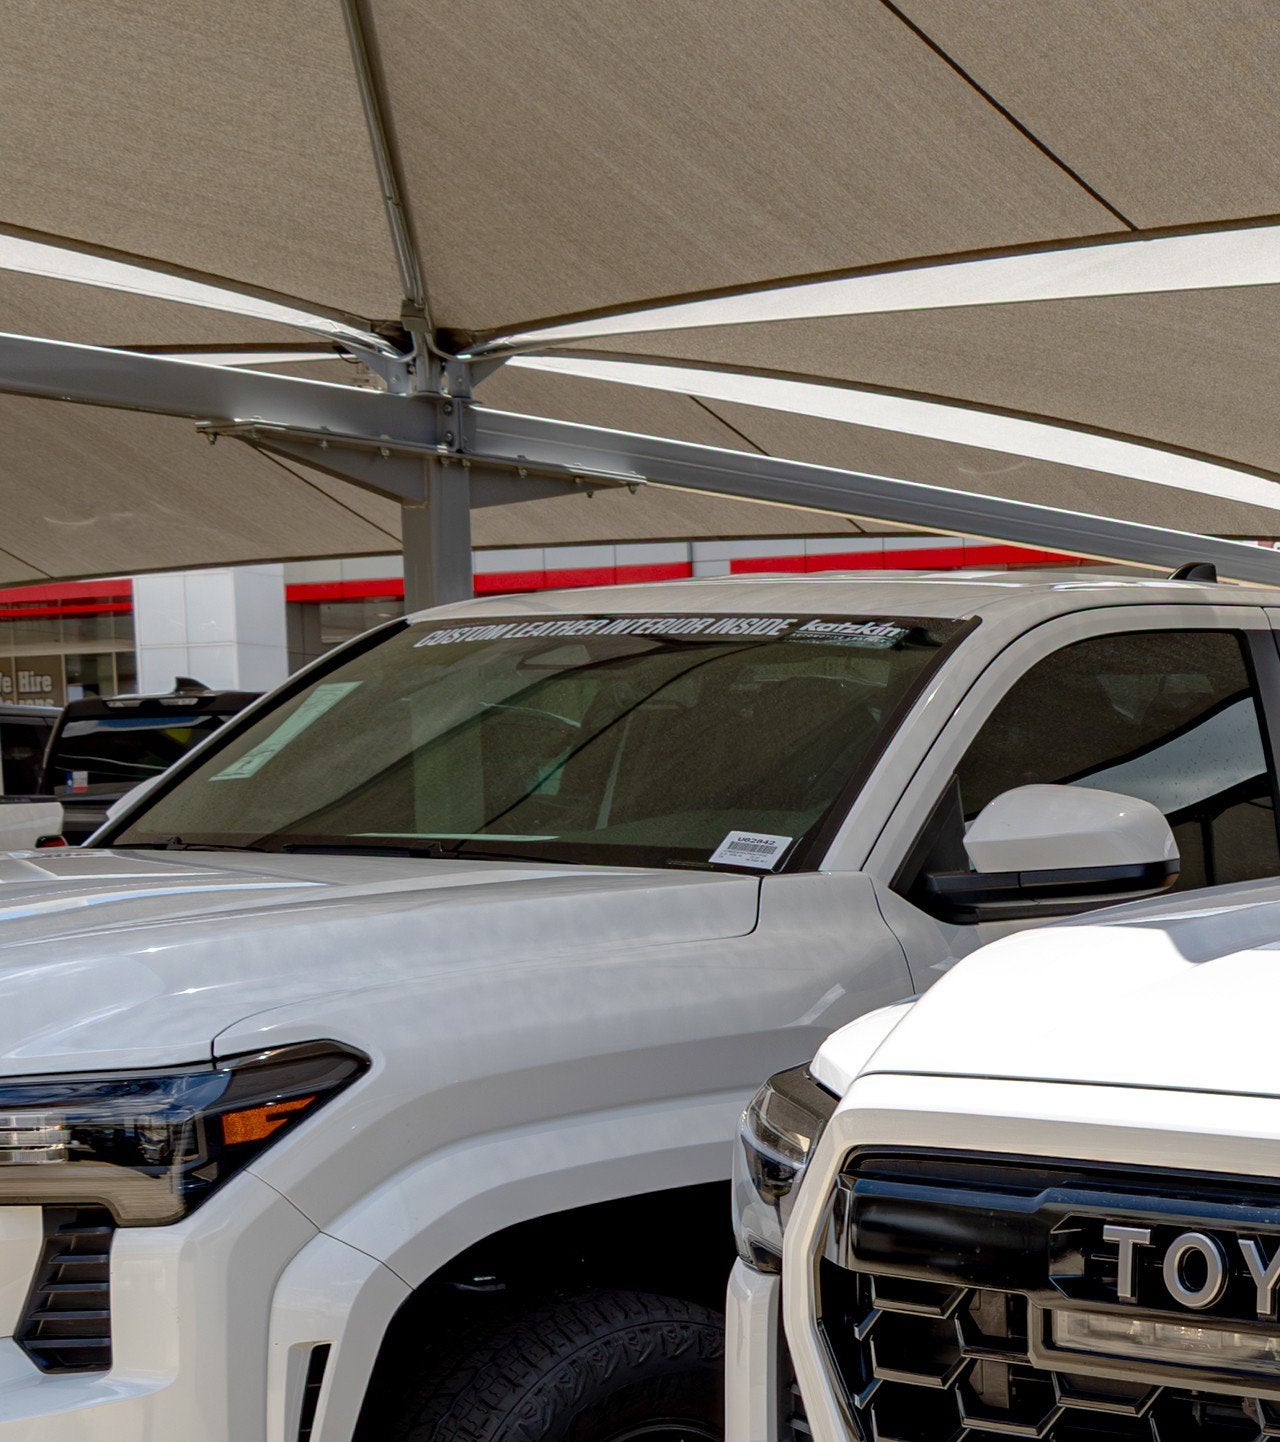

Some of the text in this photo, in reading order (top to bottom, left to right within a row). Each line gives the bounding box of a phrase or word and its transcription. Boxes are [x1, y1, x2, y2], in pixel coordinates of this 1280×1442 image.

[413, 623, 507, 648] CUSTOM
[502, 619, 611, 639] LEATHER
[596, 618, 711, 635] INTERIOR
[703, 618, 799, 636] INSIDE
[0, 670, 53, 694] e Hire
